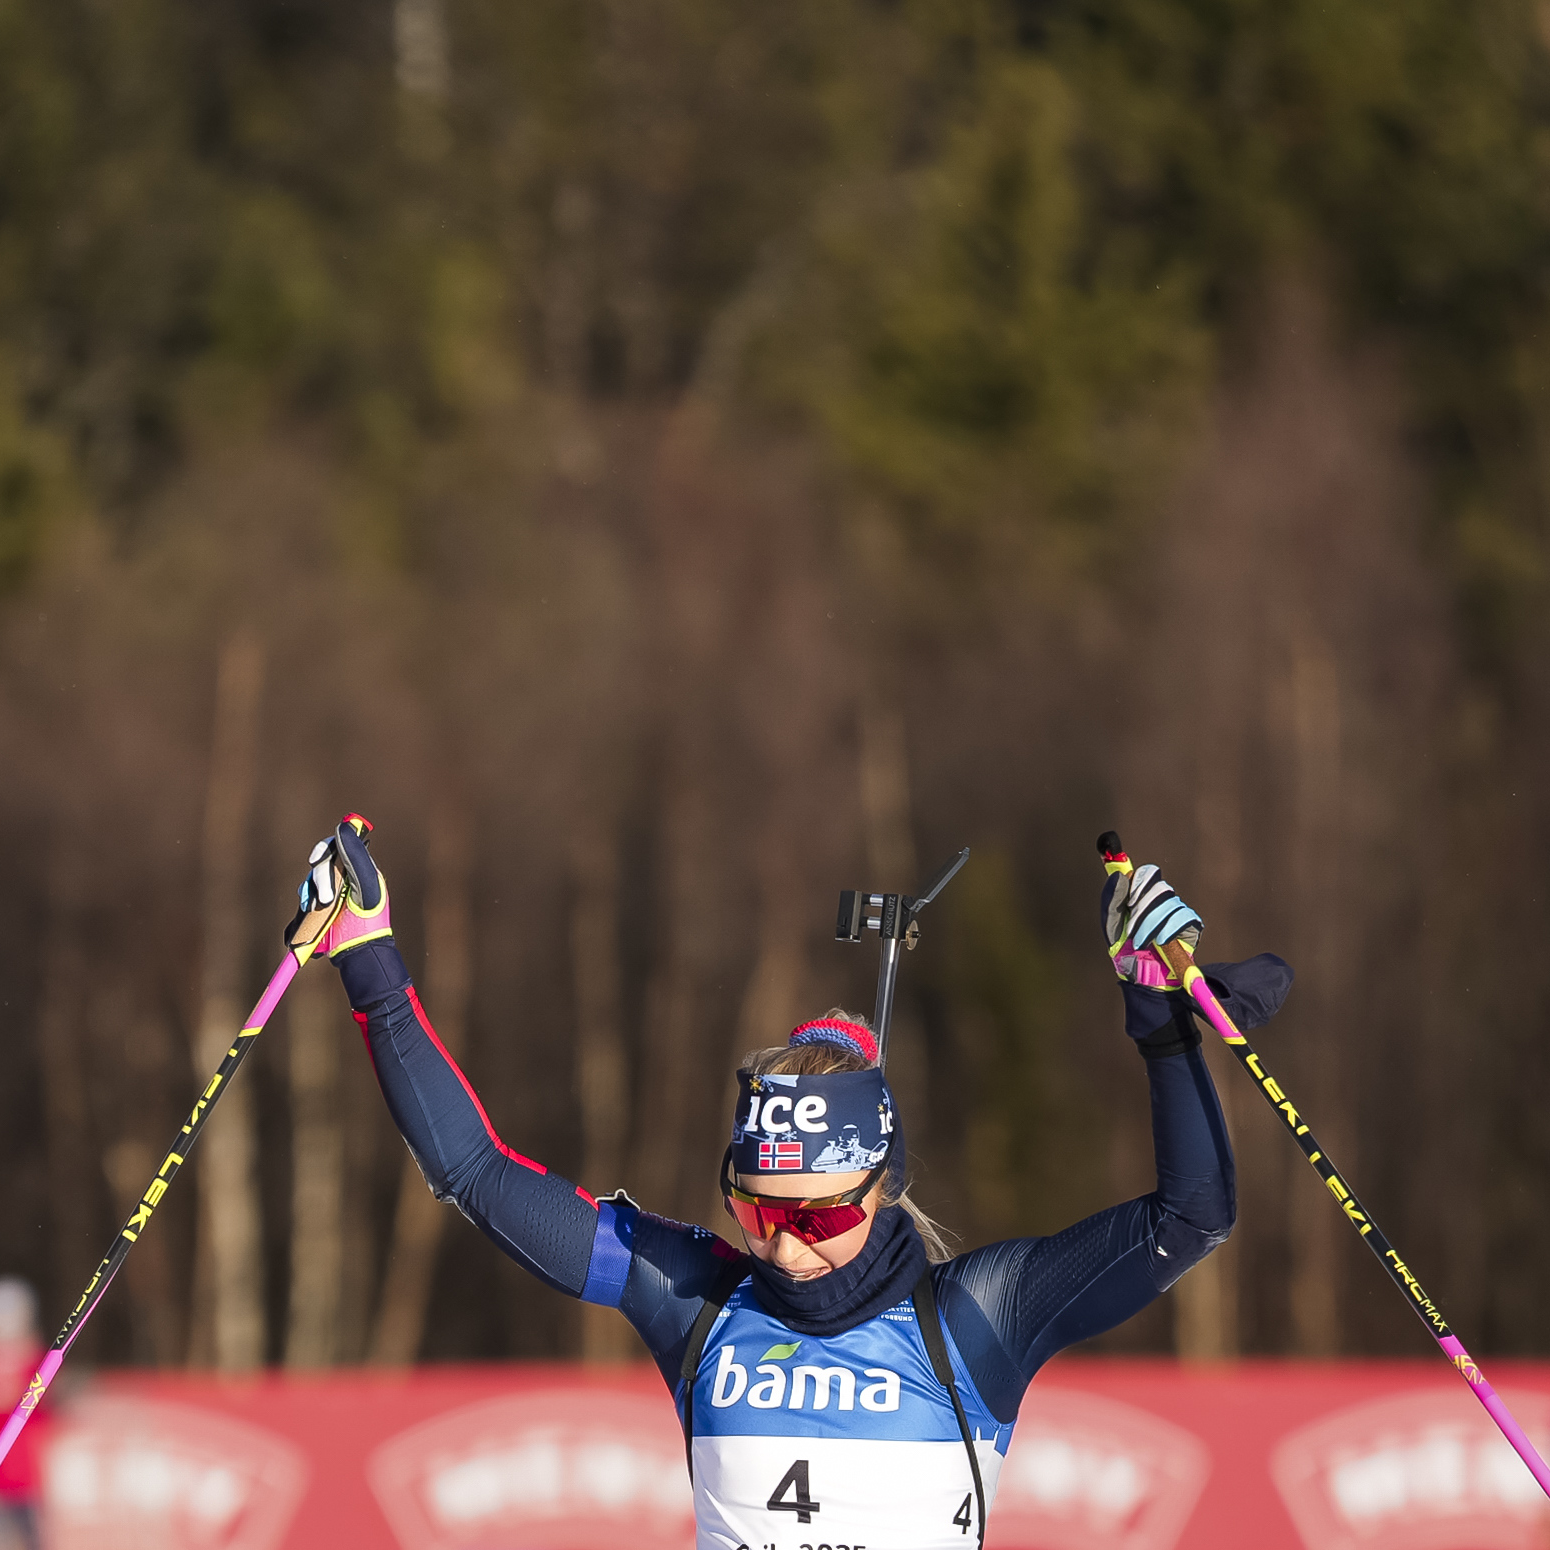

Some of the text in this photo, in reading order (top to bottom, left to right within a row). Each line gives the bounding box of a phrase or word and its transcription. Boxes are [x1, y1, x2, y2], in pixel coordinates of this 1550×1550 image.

[744, 1094, 830, 1134] ice
[1246, 1053, 1310, 1136] LEKI
[122, 1152, 184, 1243] LEKI
[766, 1459, 821, 1524] 4
[952, 1491, 974, 1535] 4
